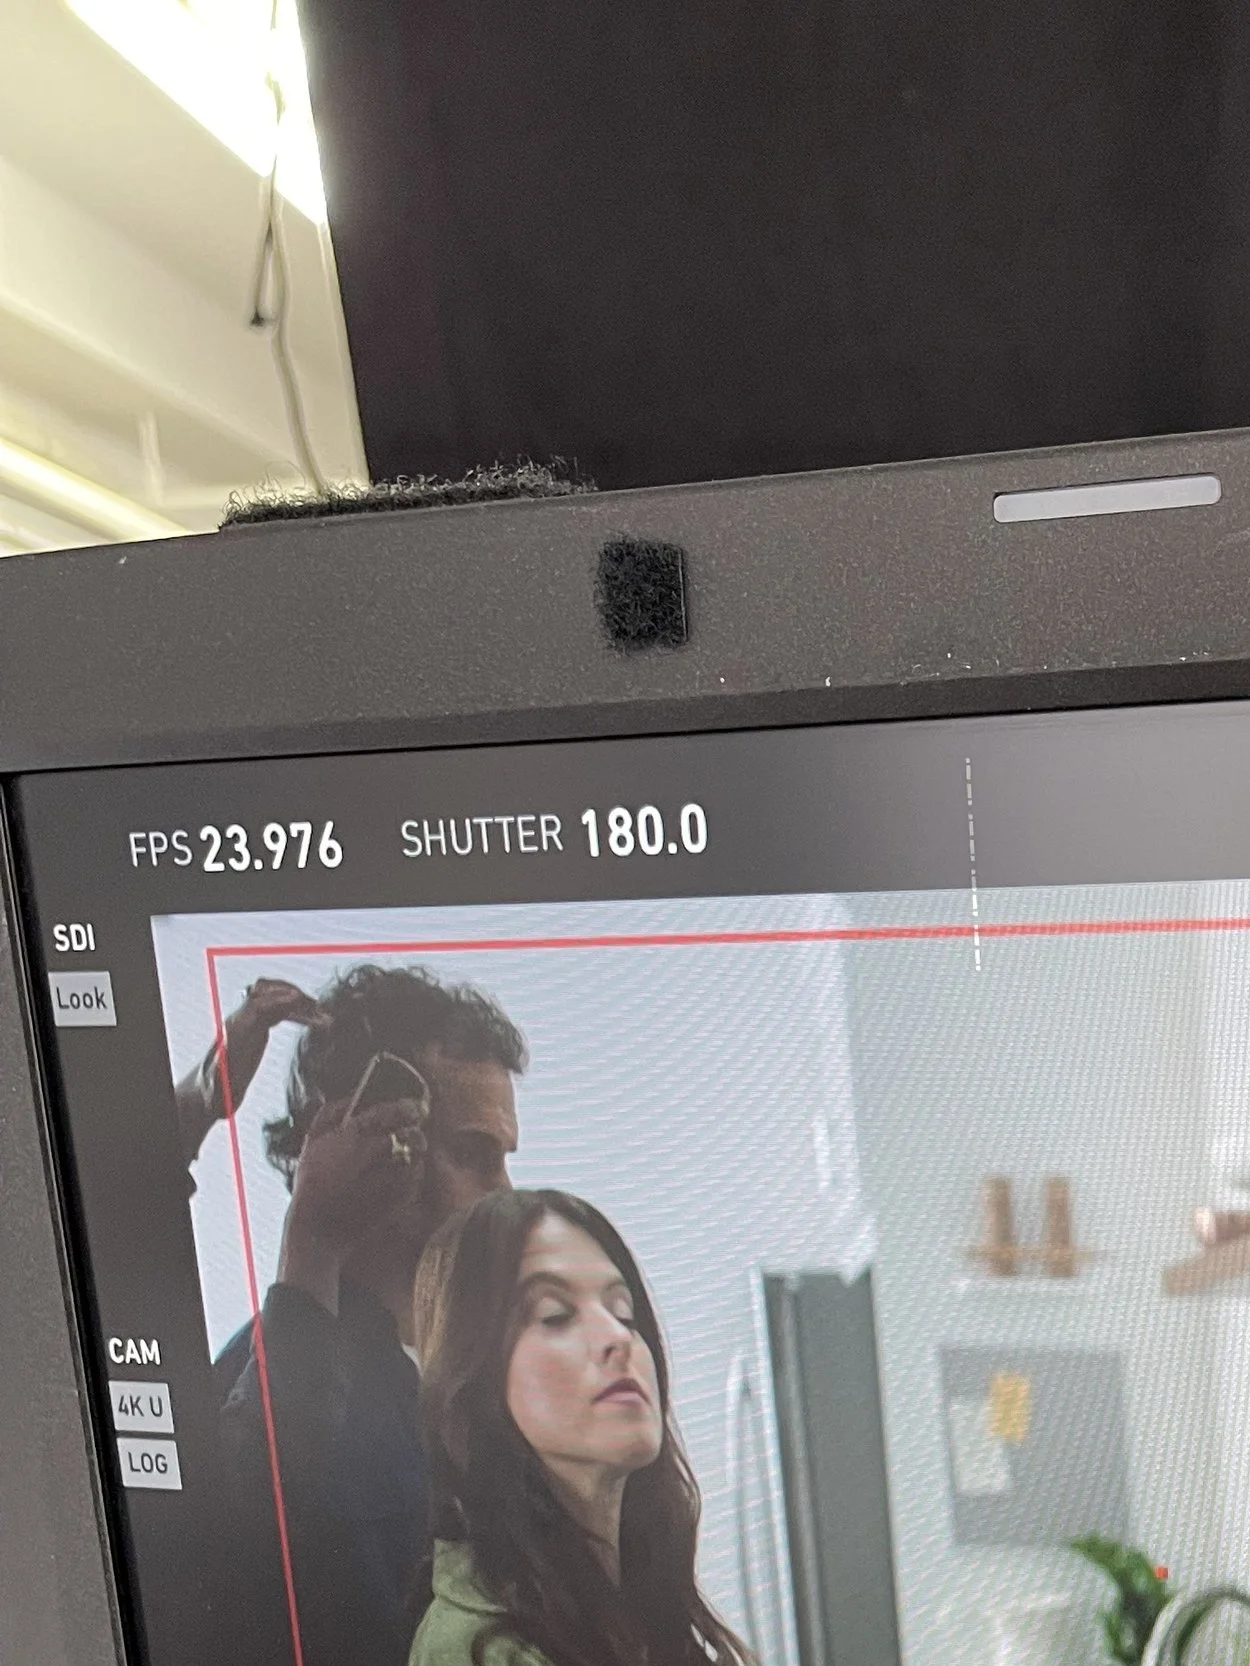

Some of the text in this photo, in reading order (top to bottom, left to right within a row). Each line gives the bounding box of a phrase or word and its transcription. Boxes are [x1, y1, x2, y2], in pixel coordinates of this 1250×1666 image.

[129, 803, 708, 873] FPS 23.976 SHUTTER 180.0
[53, 924, 96, 952] SDI
[56, 986, 108, 1011] Look
[108, 1337, 161, 1365] CAM
[118, 1395, 163, 1417] 4K U
[129, 1451, 168, 1474] LOG
